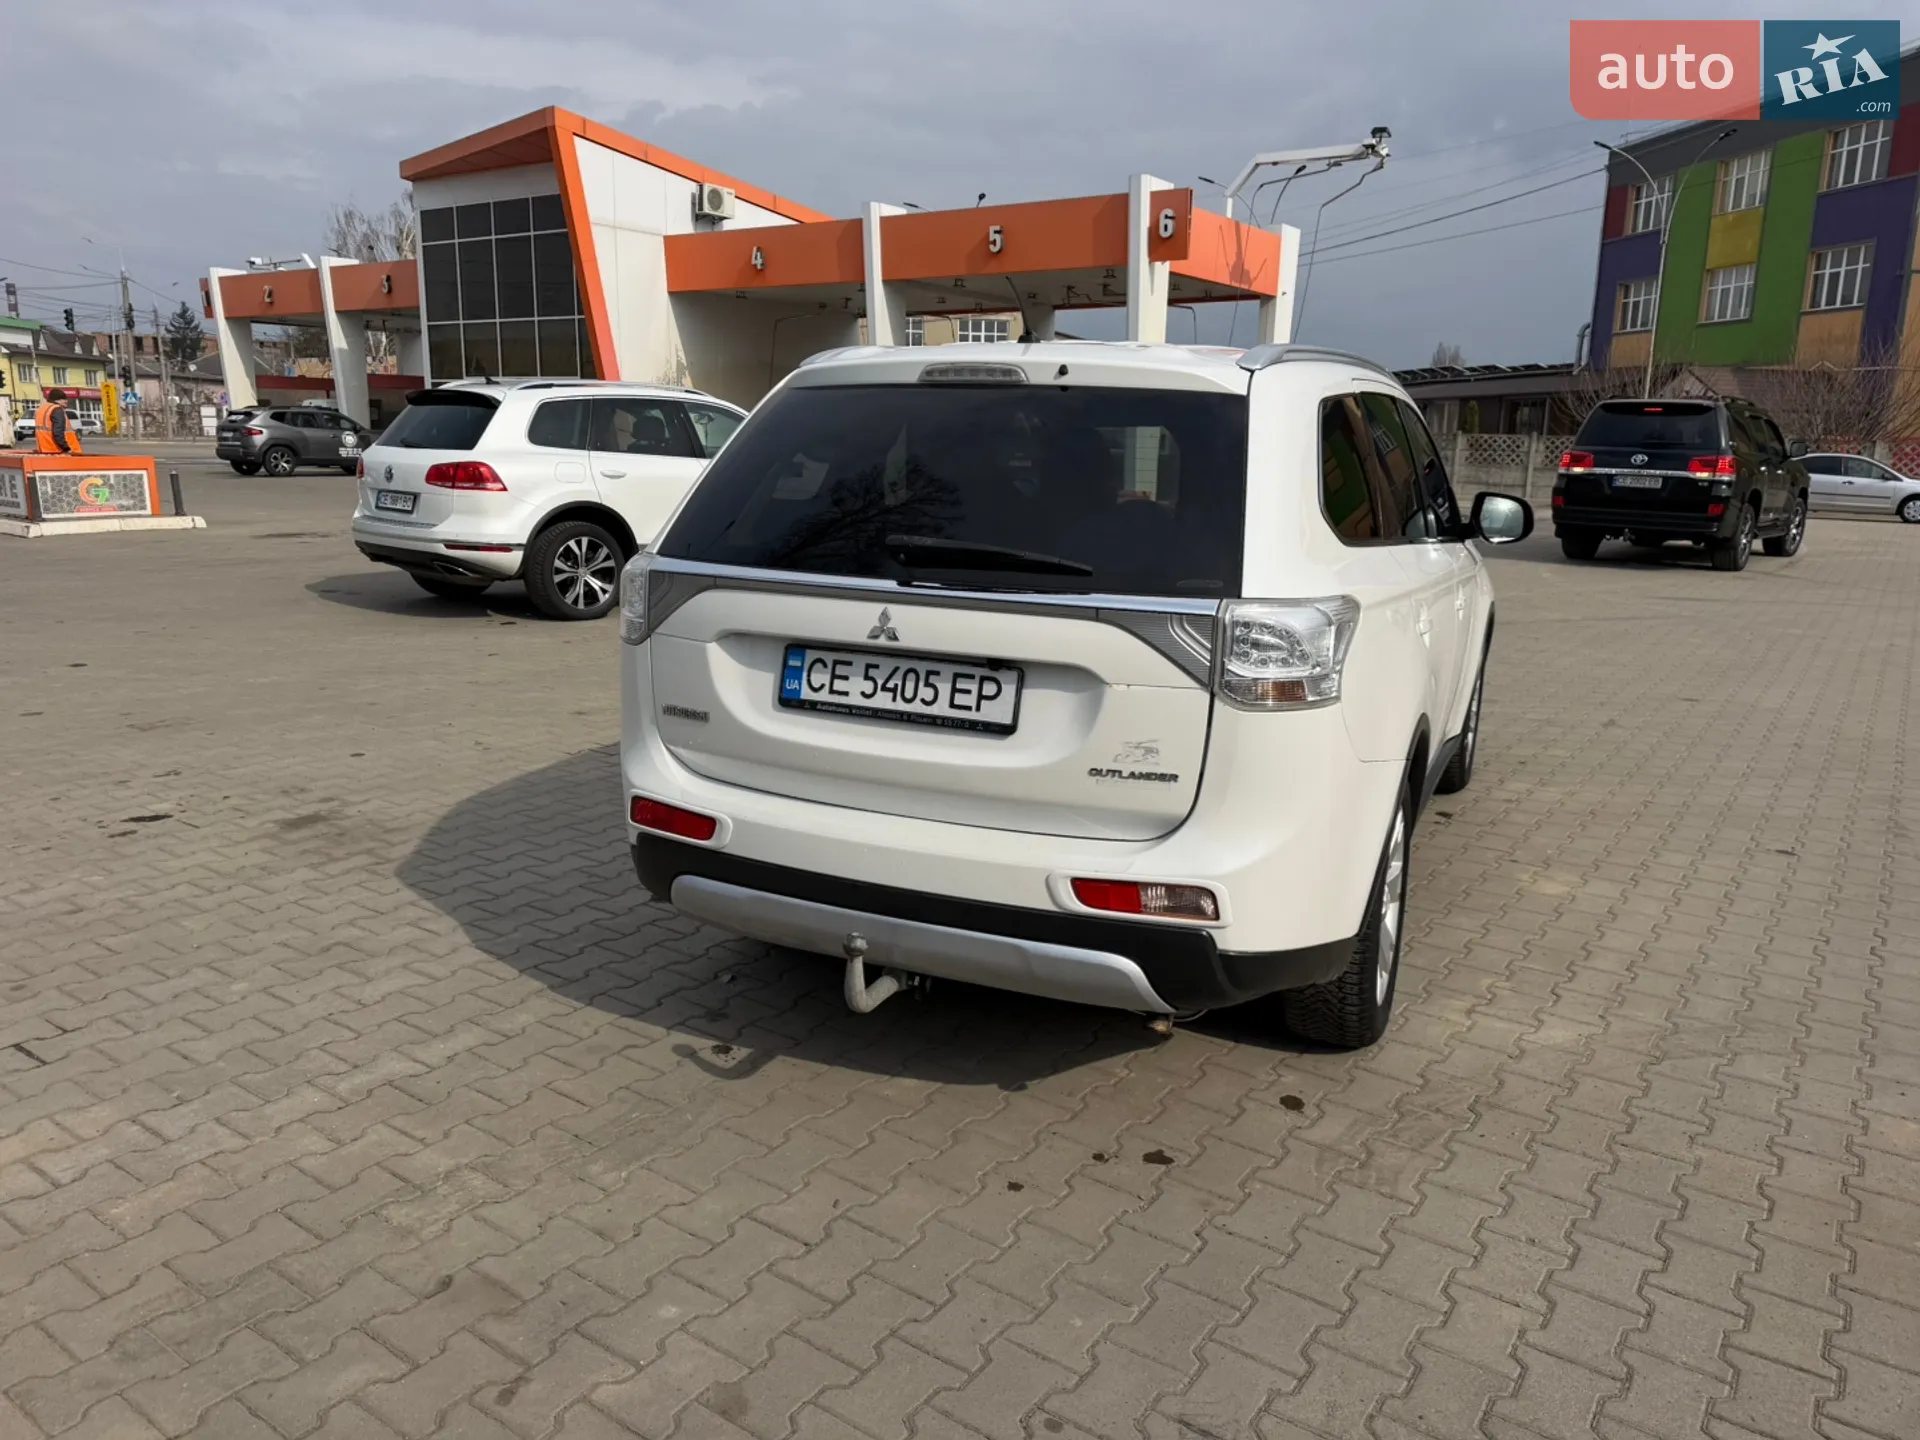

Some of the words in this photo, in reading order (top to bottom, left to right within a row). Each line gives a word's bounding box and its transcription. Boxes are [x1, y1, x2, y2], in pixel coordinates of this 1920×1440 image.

[1159, 207, 1175, 238] 6
[989, 225, 1003, 253] 5
[751, 246, 764, 270] 4
[786, 679, 799, 690] UA
[806, 657, 853, 697] CE
[860, 663, 939, 706] 5405
[949, 672, 1002, 713] EP
[1087, 768, 1179, 782] OUTLANDER
